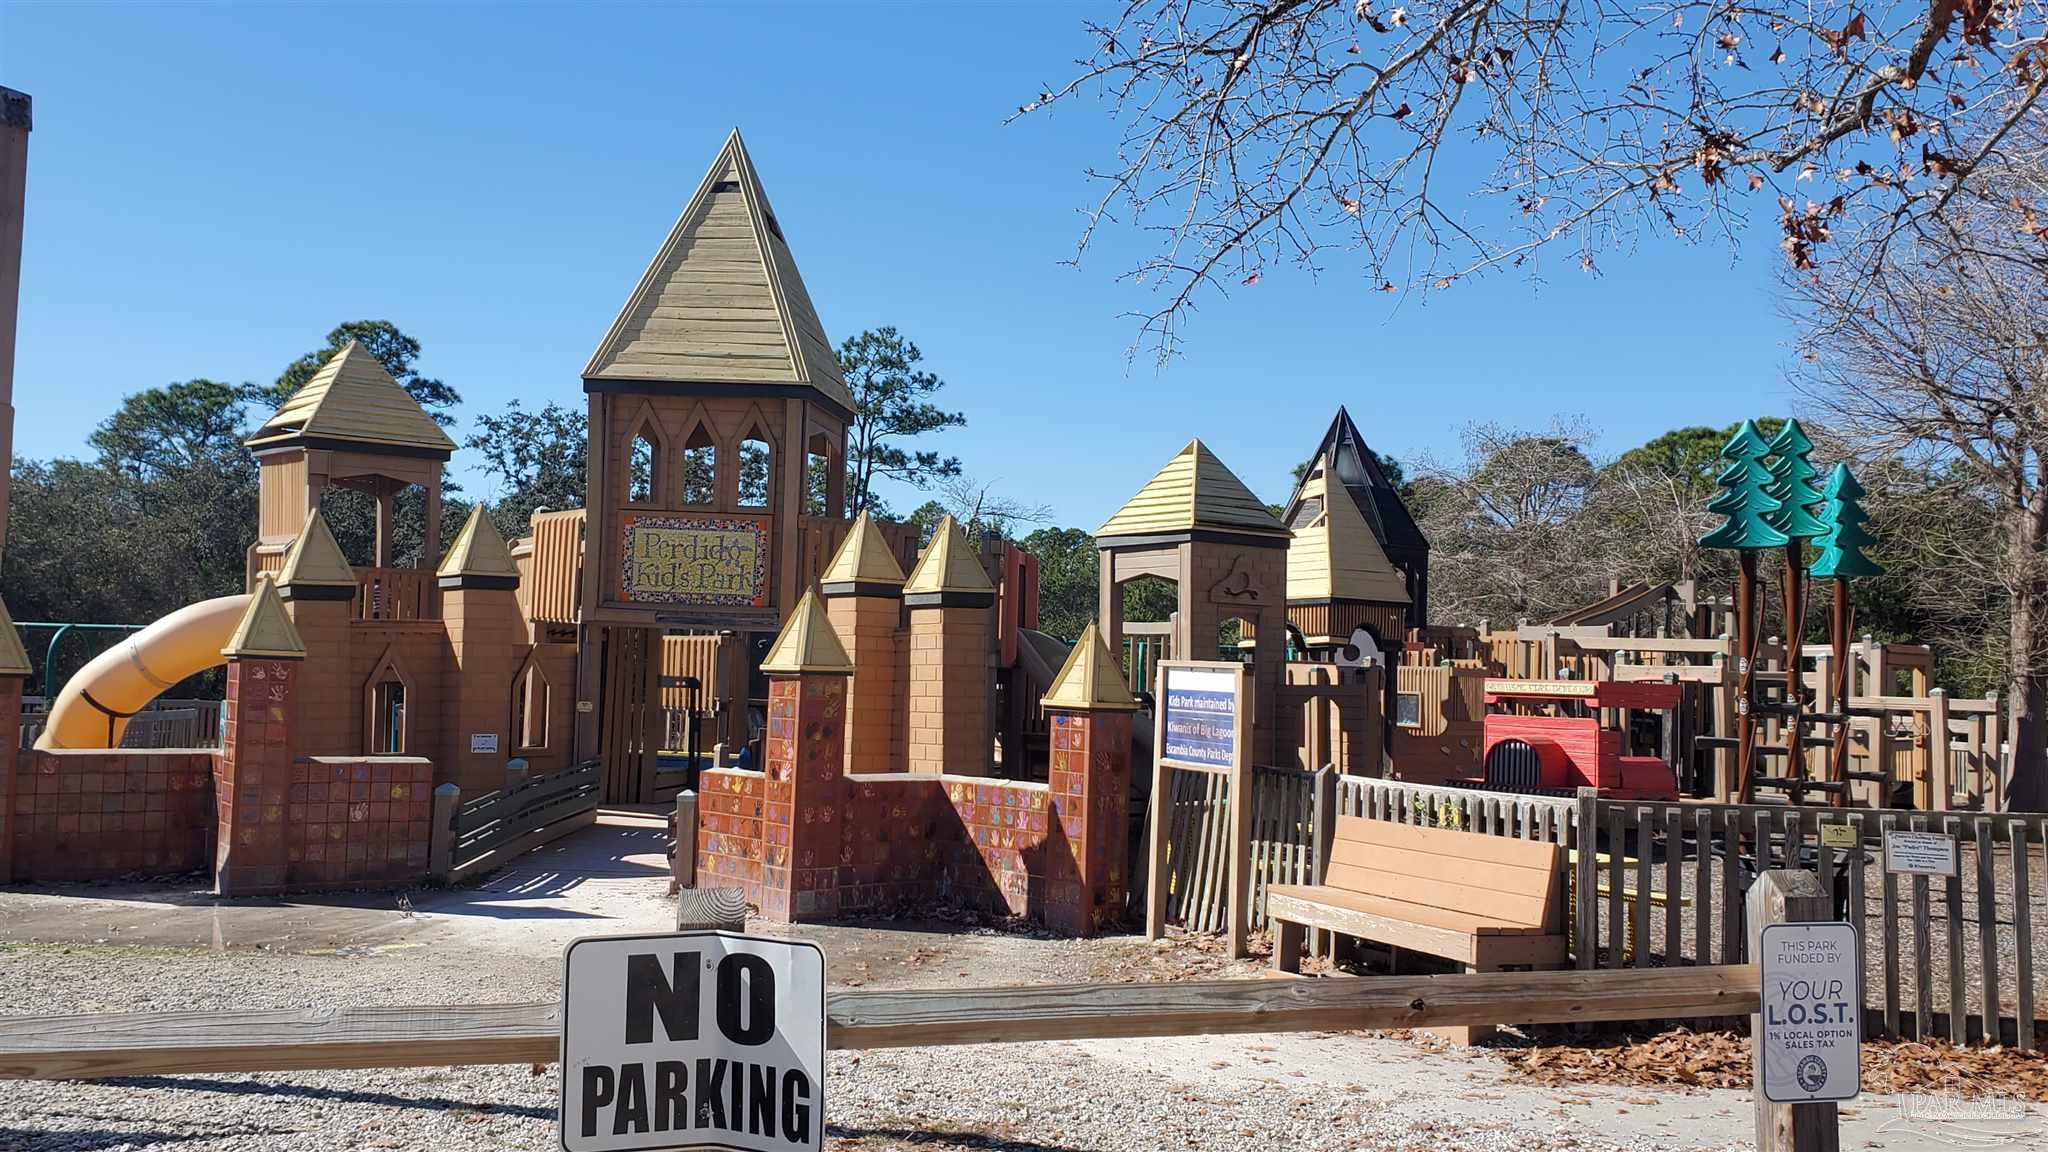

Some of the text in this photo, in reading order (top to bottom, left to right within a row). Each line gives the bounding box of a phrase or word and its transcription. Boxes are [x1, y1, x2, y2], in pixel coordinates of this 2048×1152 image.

[643, 532, 742, 561] Perdido
[634, 561, 754, 591] Kid's Park
[1168, 695, 1234, 712] Kids Park maintained by
[1168, 721, 1192, 735] Kiwanis
[1192, 723, 1200, 735] of
[1200, 724, 1211, 739] Big
[1166, 742, 1233, 764] Escambia County Parks Dep
[1780, 940, 1837, 952] THIS PARK
[1778, 952, 1842, 964] FUNDED BY
[625, 951, 776, 1046] NO
[1779, 980, 1843, 1001] YOUR
[1768, 1002, 1854, 1025] L.O.S.T.
[1769, 1029, 1853, 1040] 1% LOCAL OPTION
[1785, 1039, 1836, 1049] SALES TAX
[581, 1057, 810, 1145] PARKING
